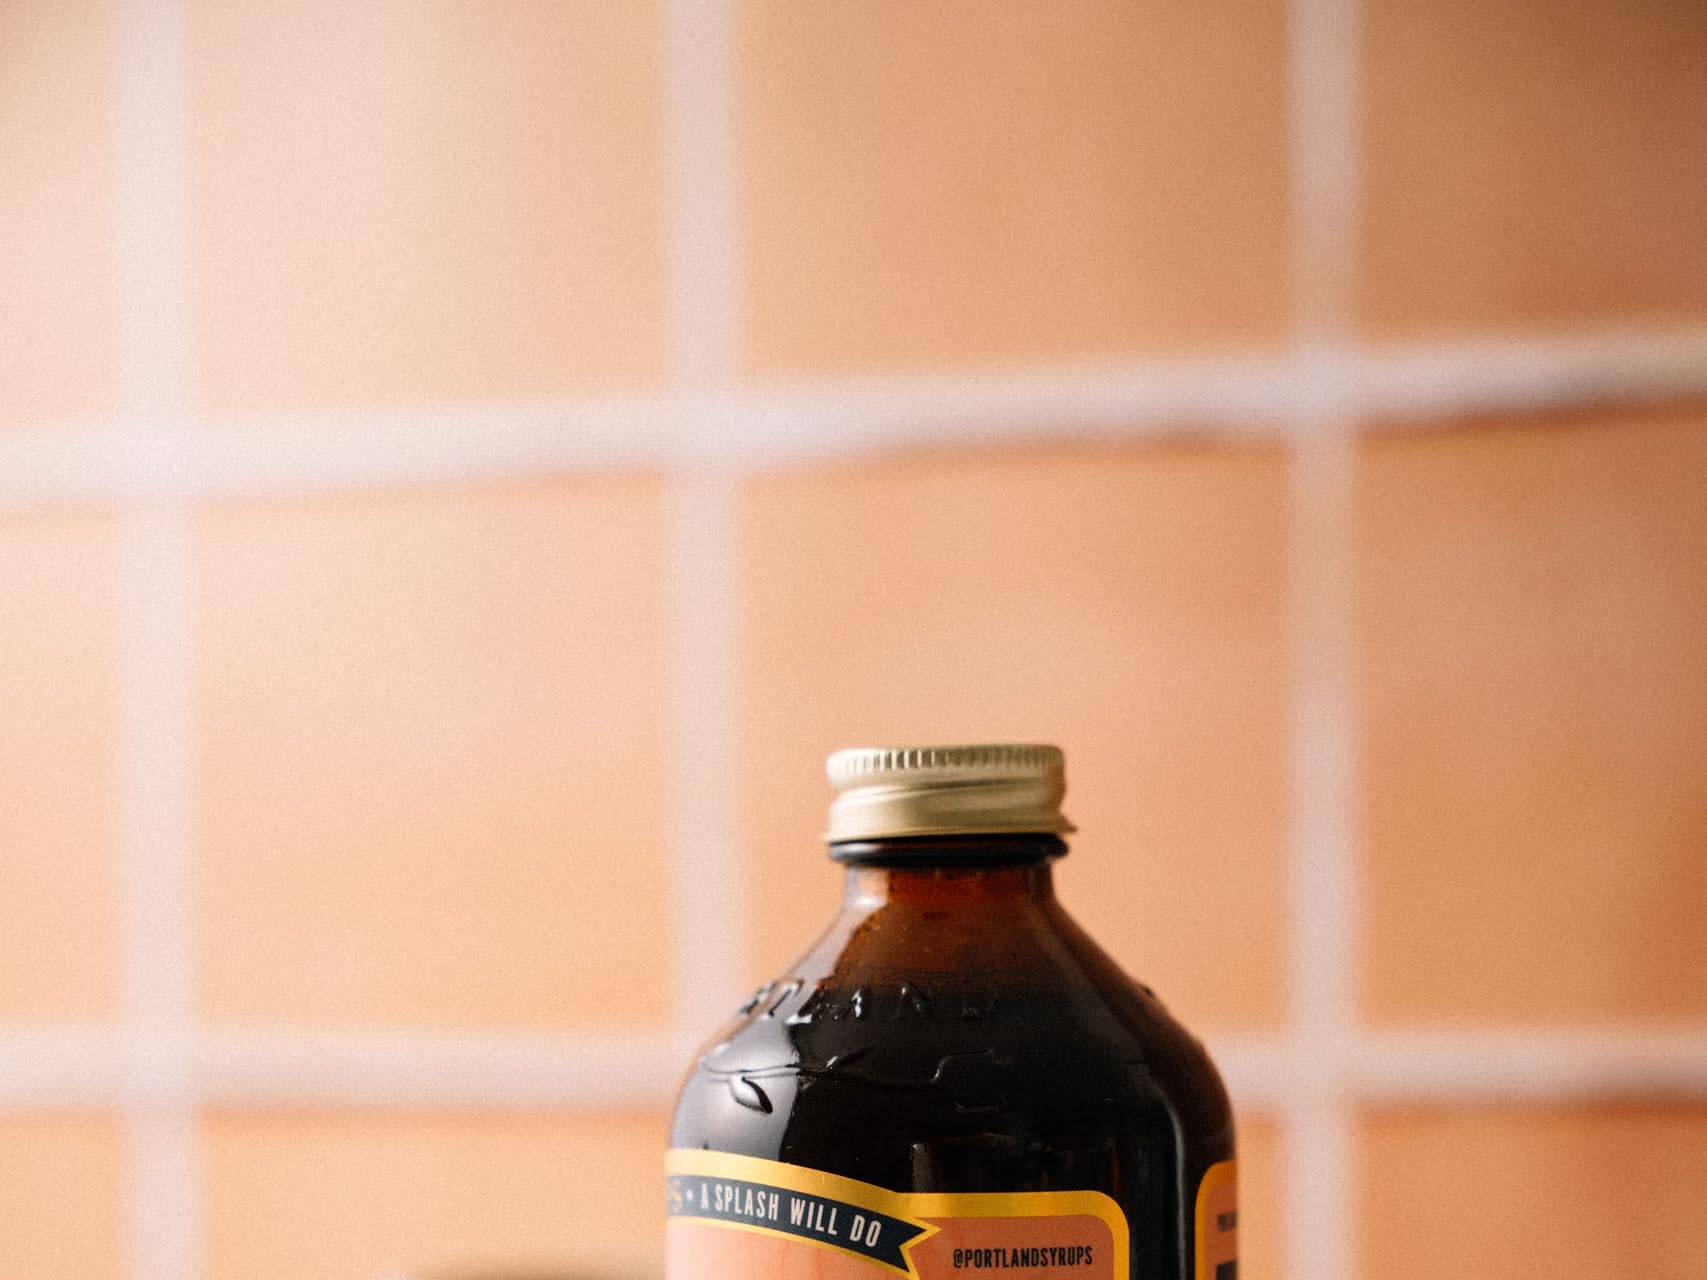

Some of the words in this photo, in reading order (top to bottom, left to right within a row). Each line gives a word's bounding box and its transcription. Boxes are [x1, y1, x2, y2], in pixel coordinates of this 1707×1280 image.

[700, 1182, 709, 1209] A
[715, 1184, 779, 1221] SPLASH
[790, 1198, 838, 1235] WILL
[850, 1215, 882, 1248] DO
[953, 1246, 1093, 1268] @PORTLANDSYRUPS
